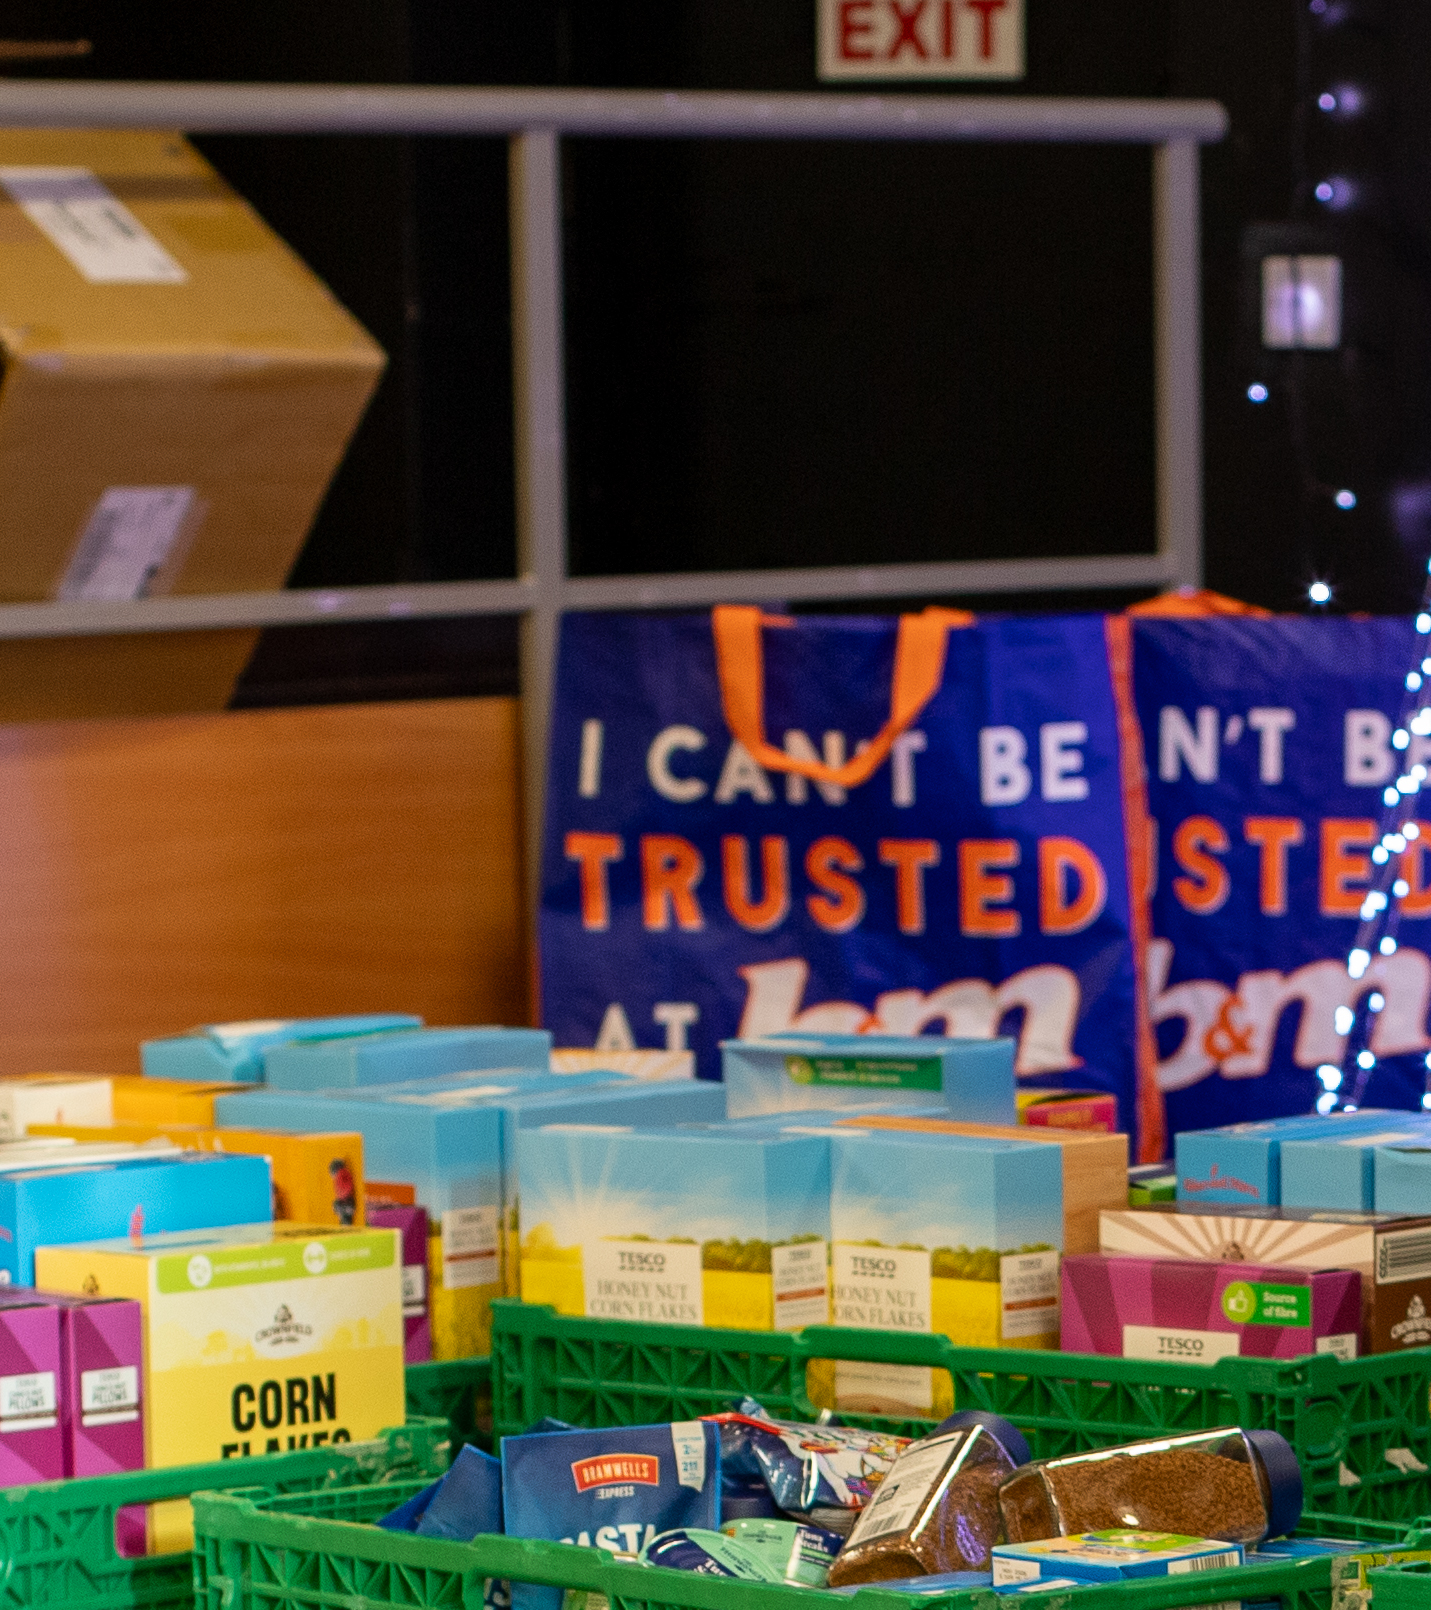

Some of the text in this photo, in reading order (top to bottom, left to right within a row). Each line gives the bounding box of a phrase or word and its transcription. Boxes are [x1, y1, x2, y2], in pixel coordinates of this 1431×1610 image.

[837, 0, 1004, 60] EXIT
[578, 719, 604, 799] I
[979, 721, 1091, 807] BE
[565, 829, 1108, 938] TRUSTED
[619, 1251, 667, 1267] TESCO
[851, 1256, 897, 1273] TESCO
[597, 1280, 688, 1301] HONEY NUT
[885, 1289, 918, 1308] NUT
[589, 1300, 698, 1321] CORN FLAKES
[870, 1306, 927, 1328] FLAKES
[1157, 1335, 1204, 1351] TESCO
[231, 1371, 337, 1433] CORN
[582, 1460, 650, 1484] BRAMWELLS
